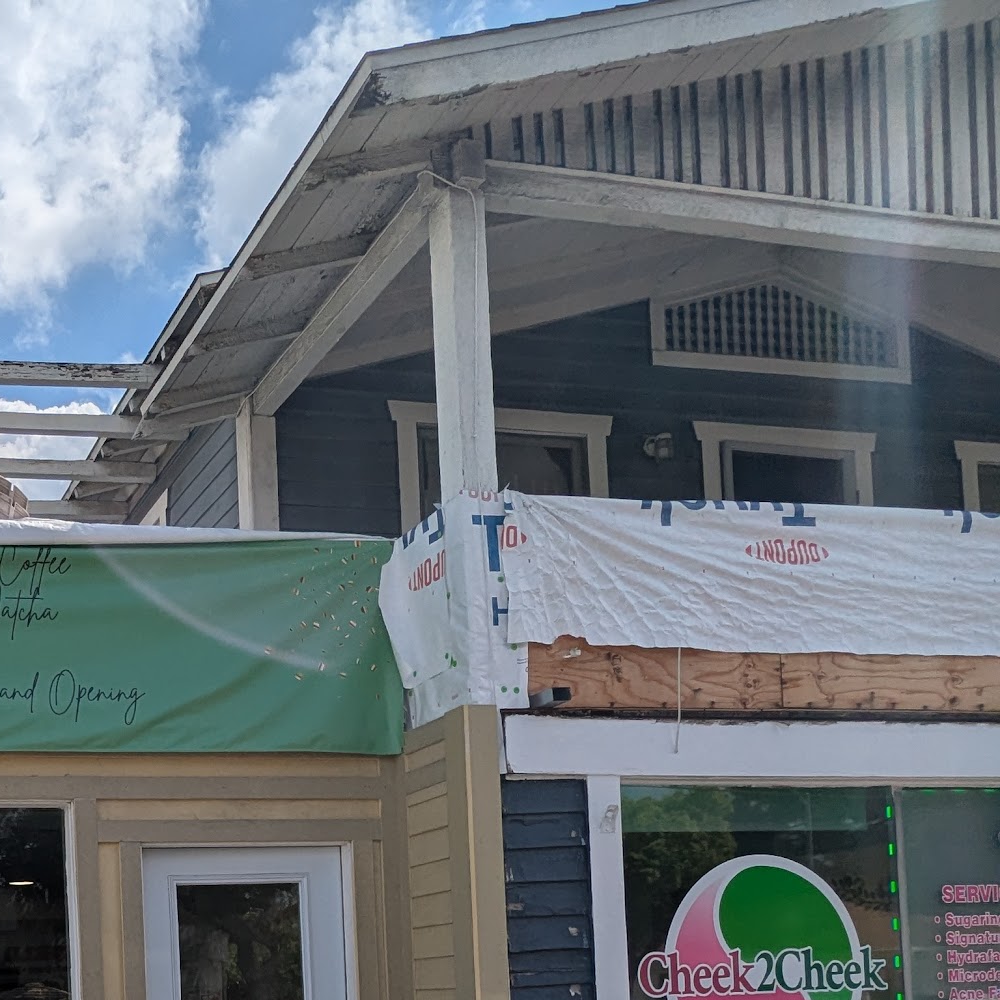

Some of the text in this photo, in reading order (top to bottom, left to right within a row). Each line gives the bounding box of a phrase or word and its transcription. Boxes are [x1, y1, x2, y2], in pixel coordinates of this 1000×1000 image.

[755, 538, 820, 565] DUPONT
[49, 669, 146, 725] Opening
[942, 885, 1000, 903] SERVI
[945, 912, 1000, 929] Sugarin
[638, 946, 888, 998] Cheek2Cheek
[949, 987, 984, 1000] Acne
